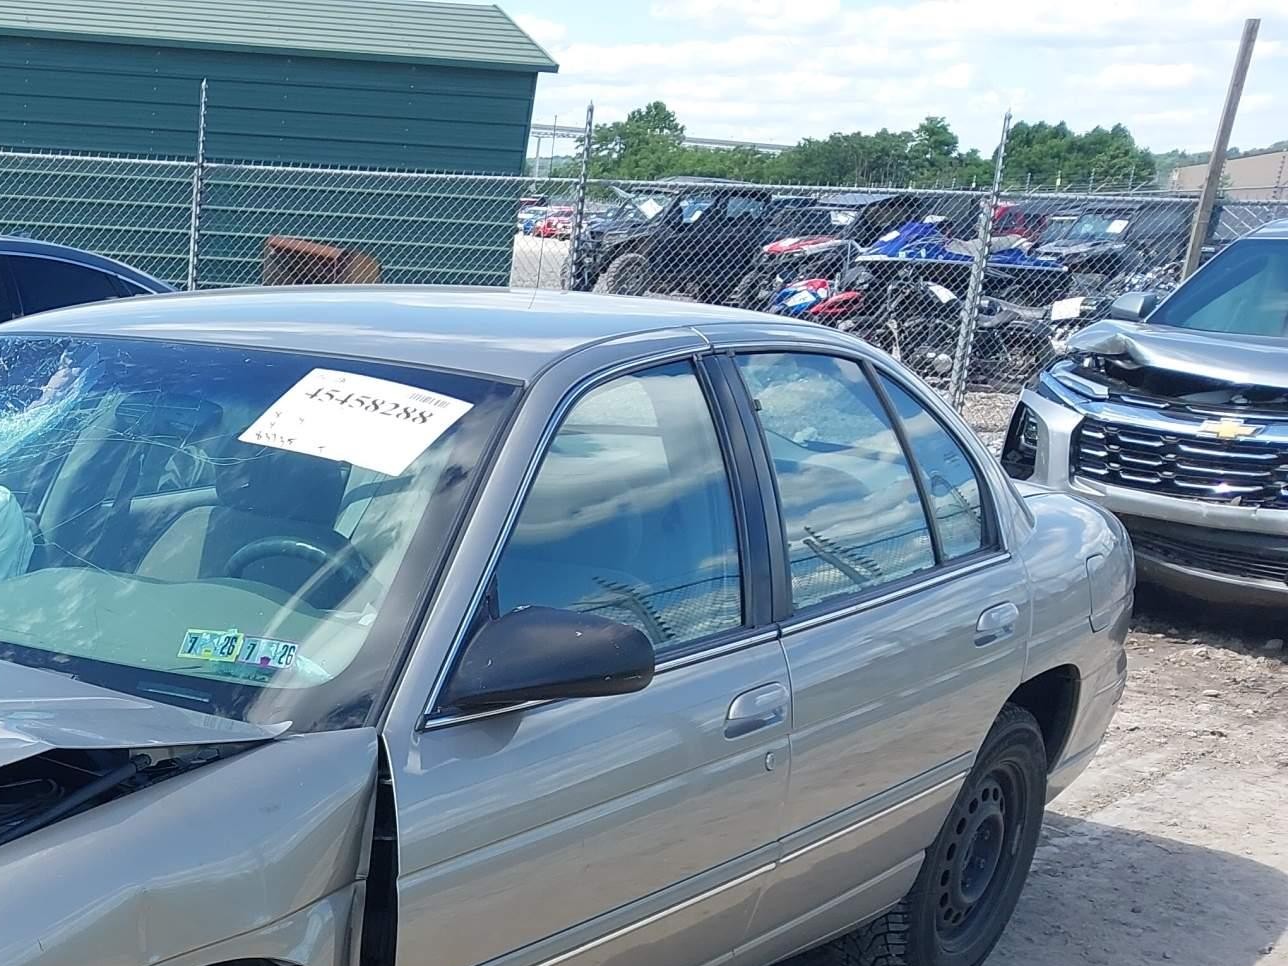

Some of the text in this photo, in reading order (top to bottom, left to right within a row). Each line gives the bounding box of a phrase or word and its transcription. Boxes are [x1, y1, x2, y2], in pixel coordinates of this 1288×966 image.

[305, 387, 433, 424] 45458288
[187, 635, 238, 656] 7 26
[246, 643, 296, 666] 7 26
